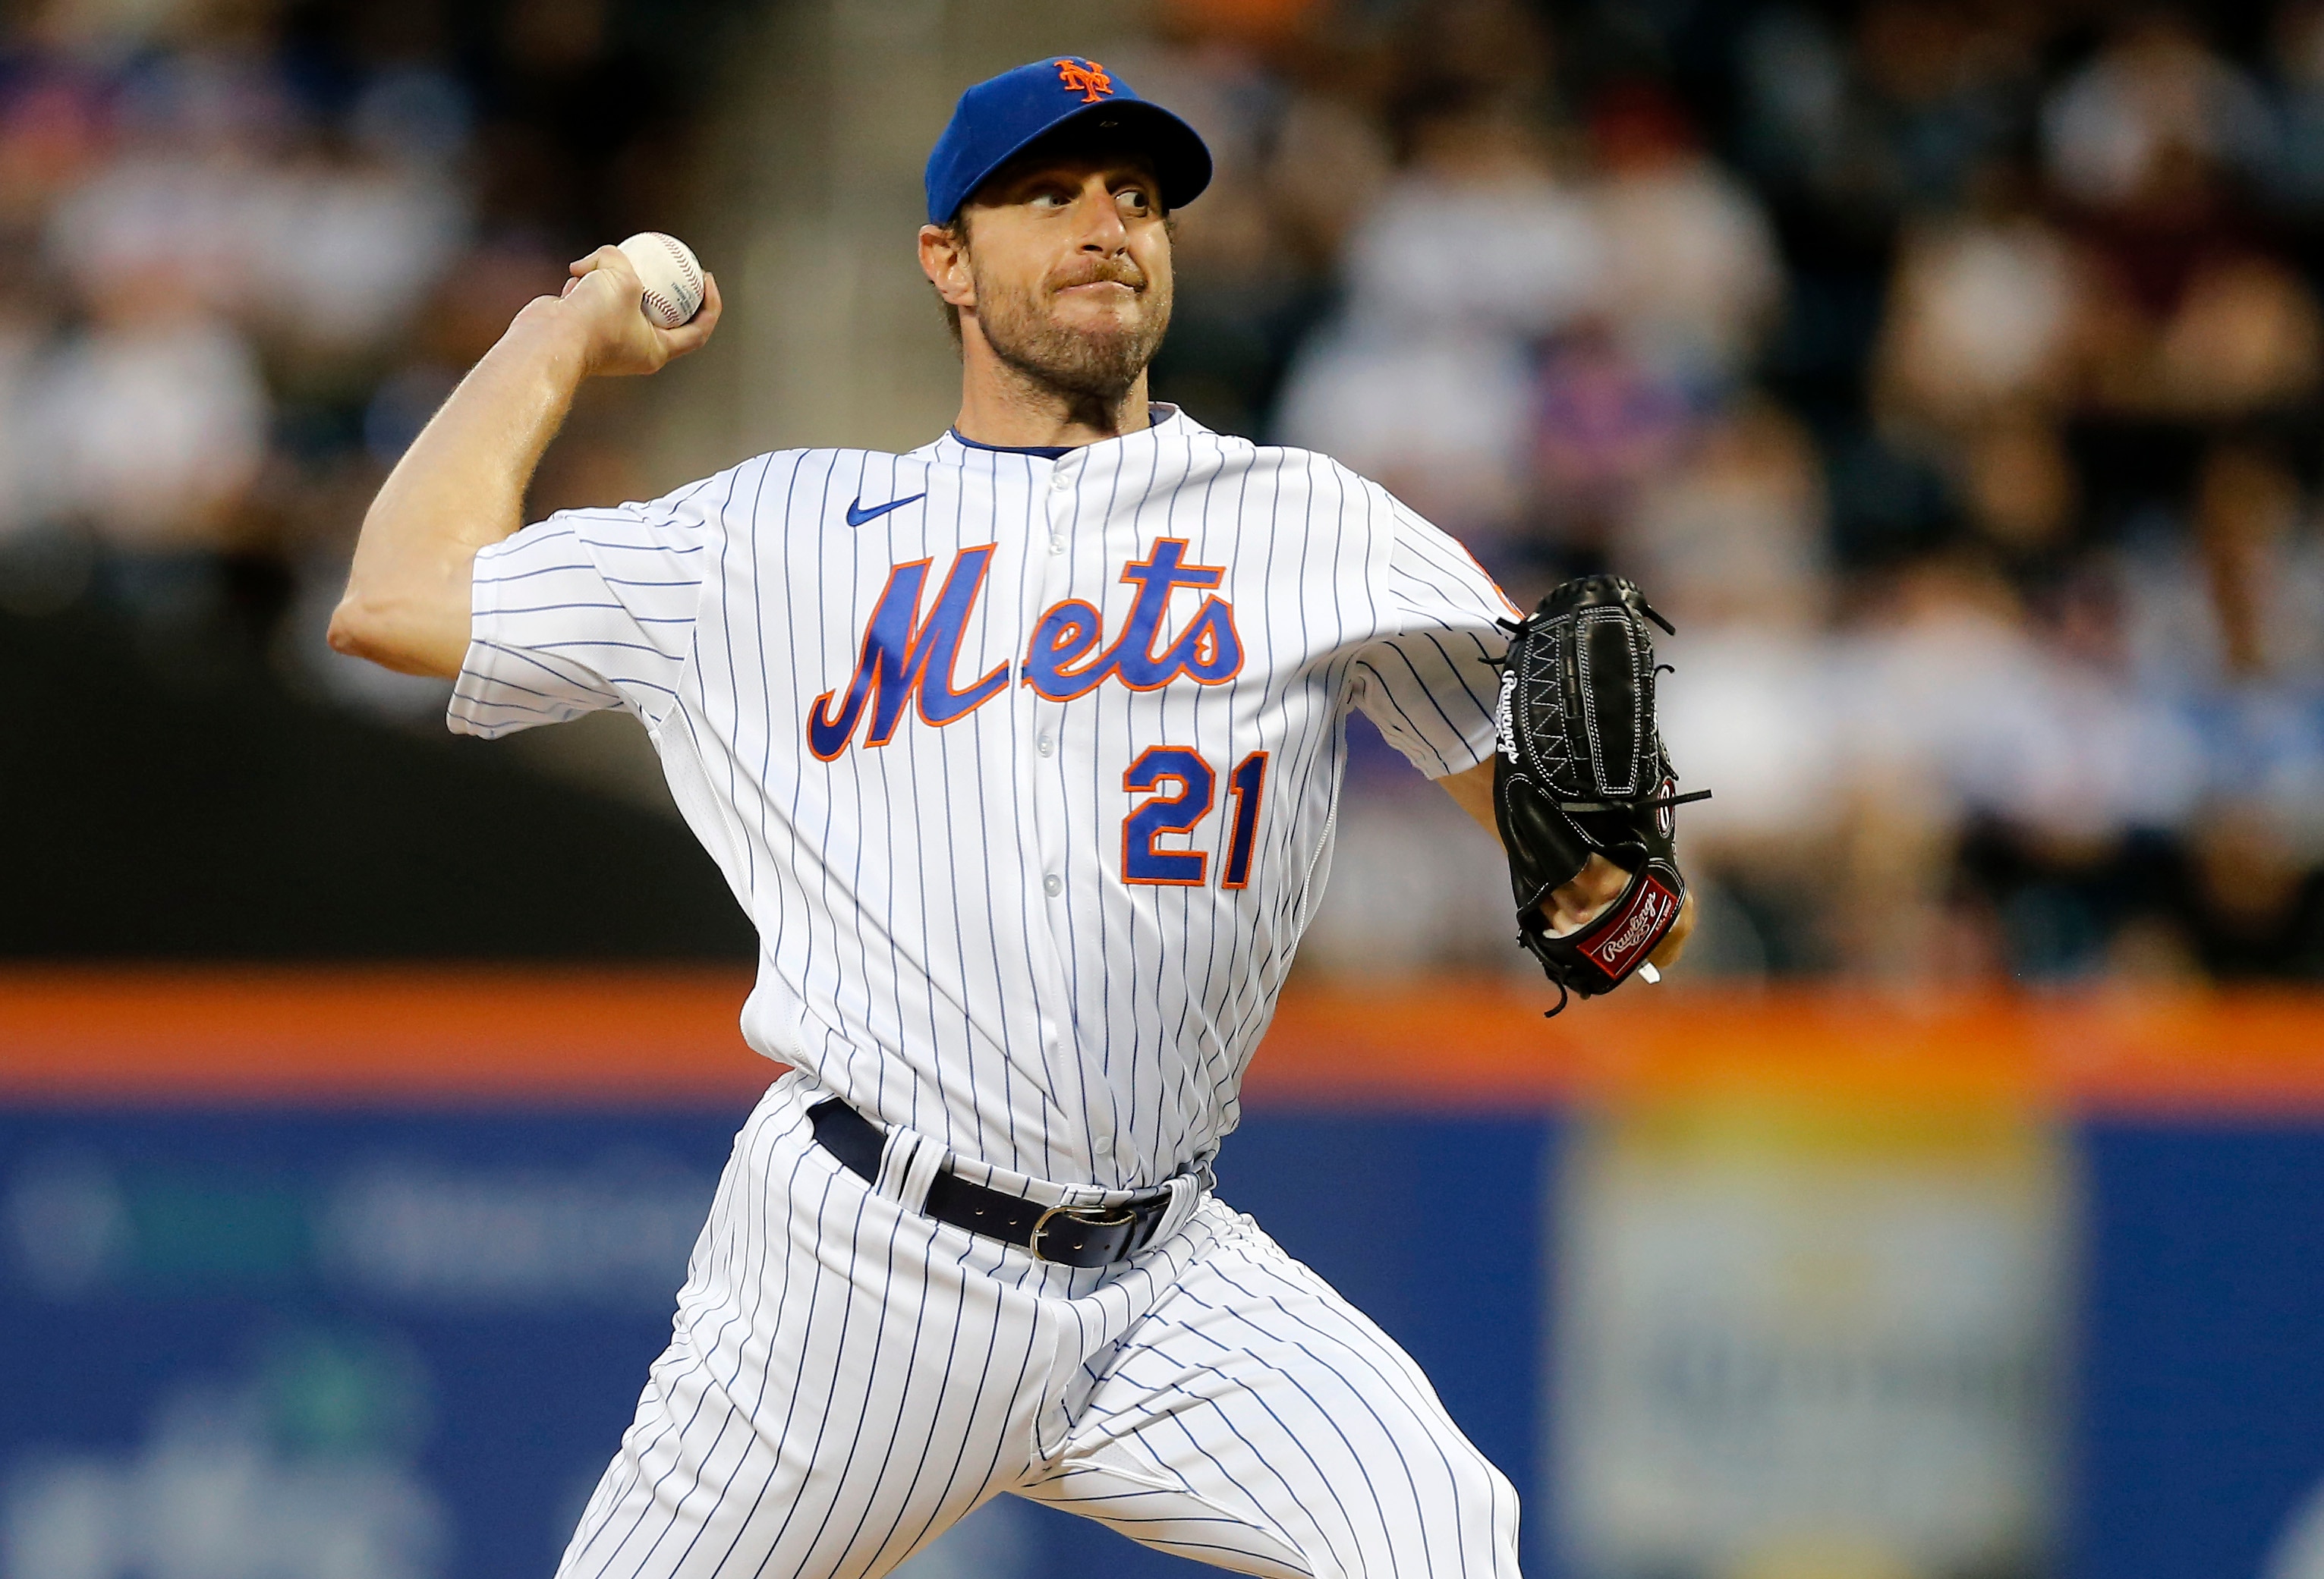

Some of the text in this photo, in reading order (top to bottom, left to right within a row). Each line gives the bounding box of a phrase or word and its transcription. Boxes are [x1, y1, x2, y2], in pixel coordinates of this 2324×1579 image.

[1053, 59, 1113, 103] NY
[808, 536, 1245, 762] Mets
[1496, 670, 1519, 764] Rawlings
[1121, 745, 1269, 889] 21
[1602, 892, 1656, 962] Rawlings
